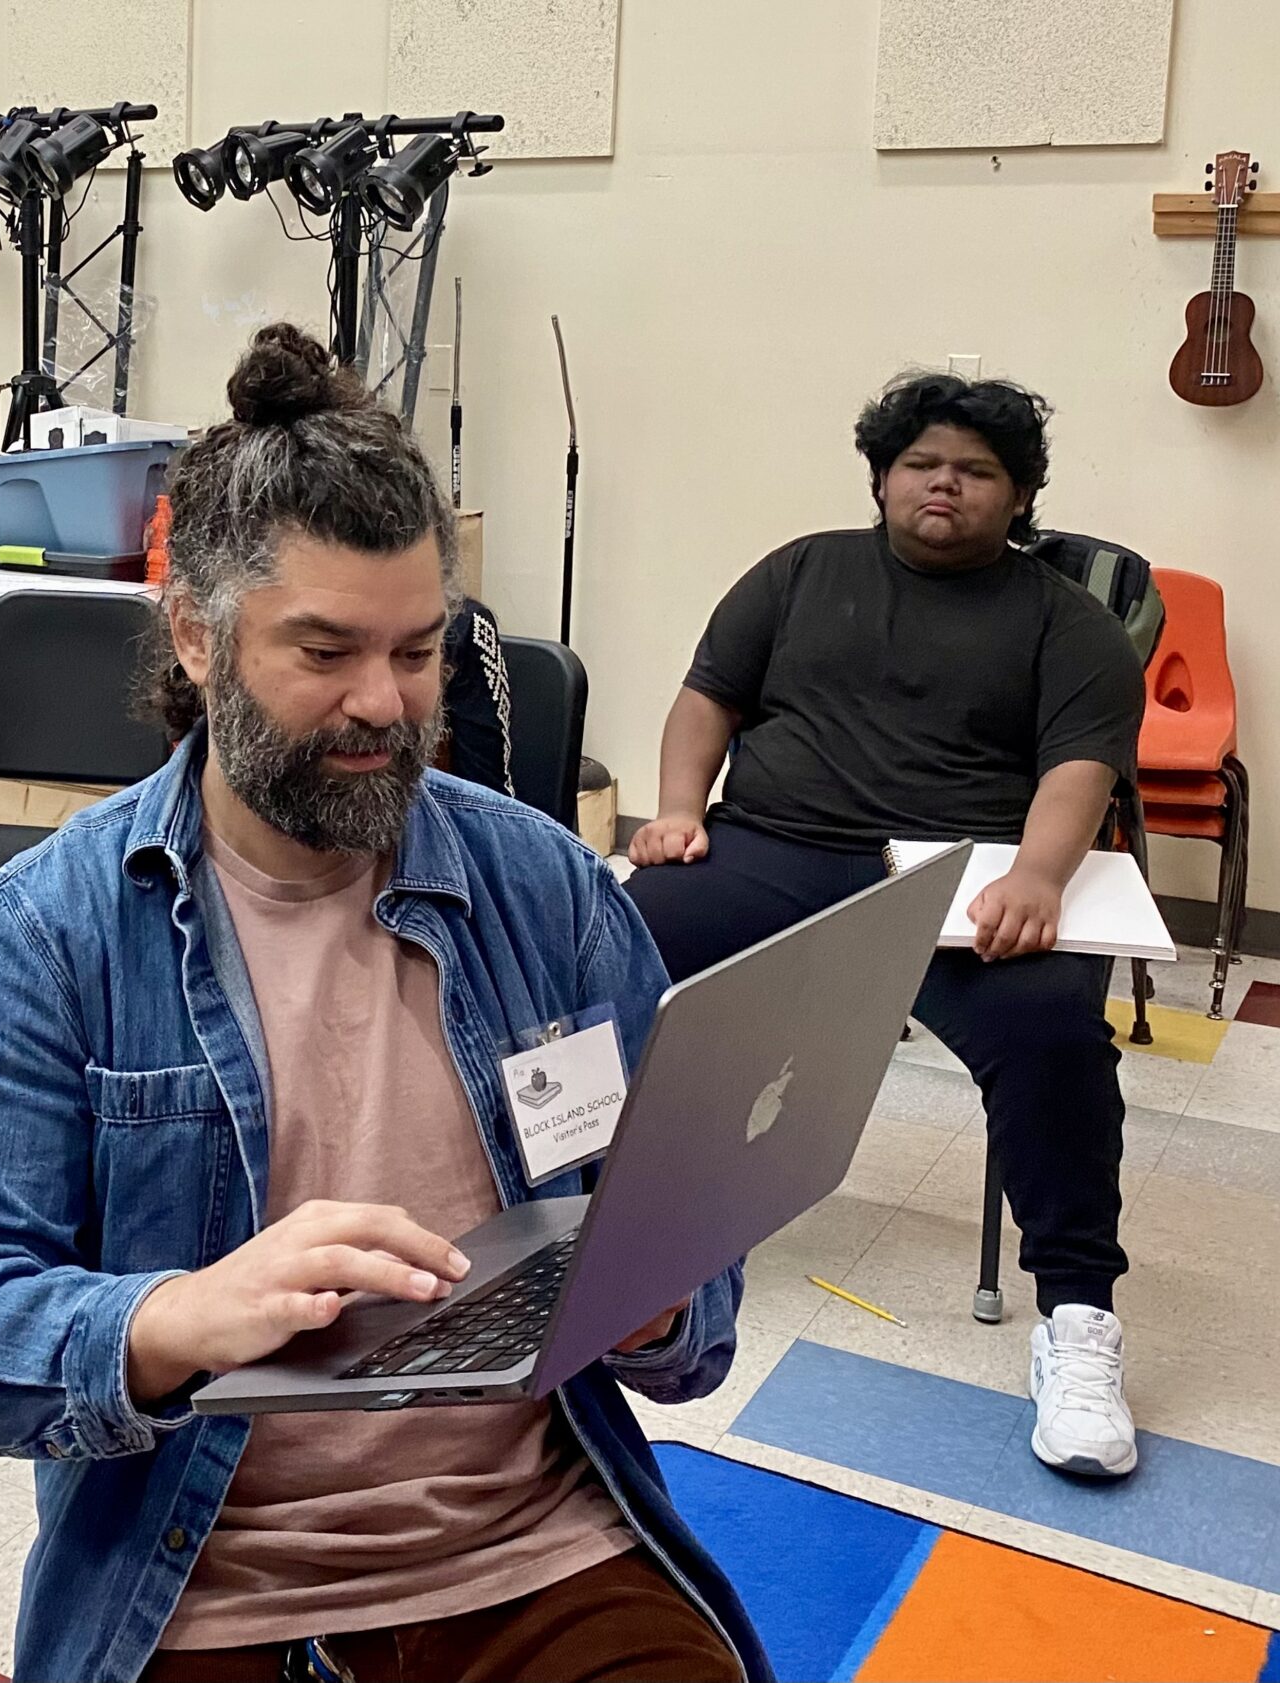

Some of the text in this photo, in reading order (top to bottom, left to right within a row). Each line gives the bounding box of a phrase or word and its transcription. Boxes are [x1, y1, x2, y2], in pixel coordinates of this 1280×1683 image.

[523, 1091, 623, 1139] BLOCK ISLAND SCHOOL
[553, 1118, 600, 1143] Visitor's Pass
